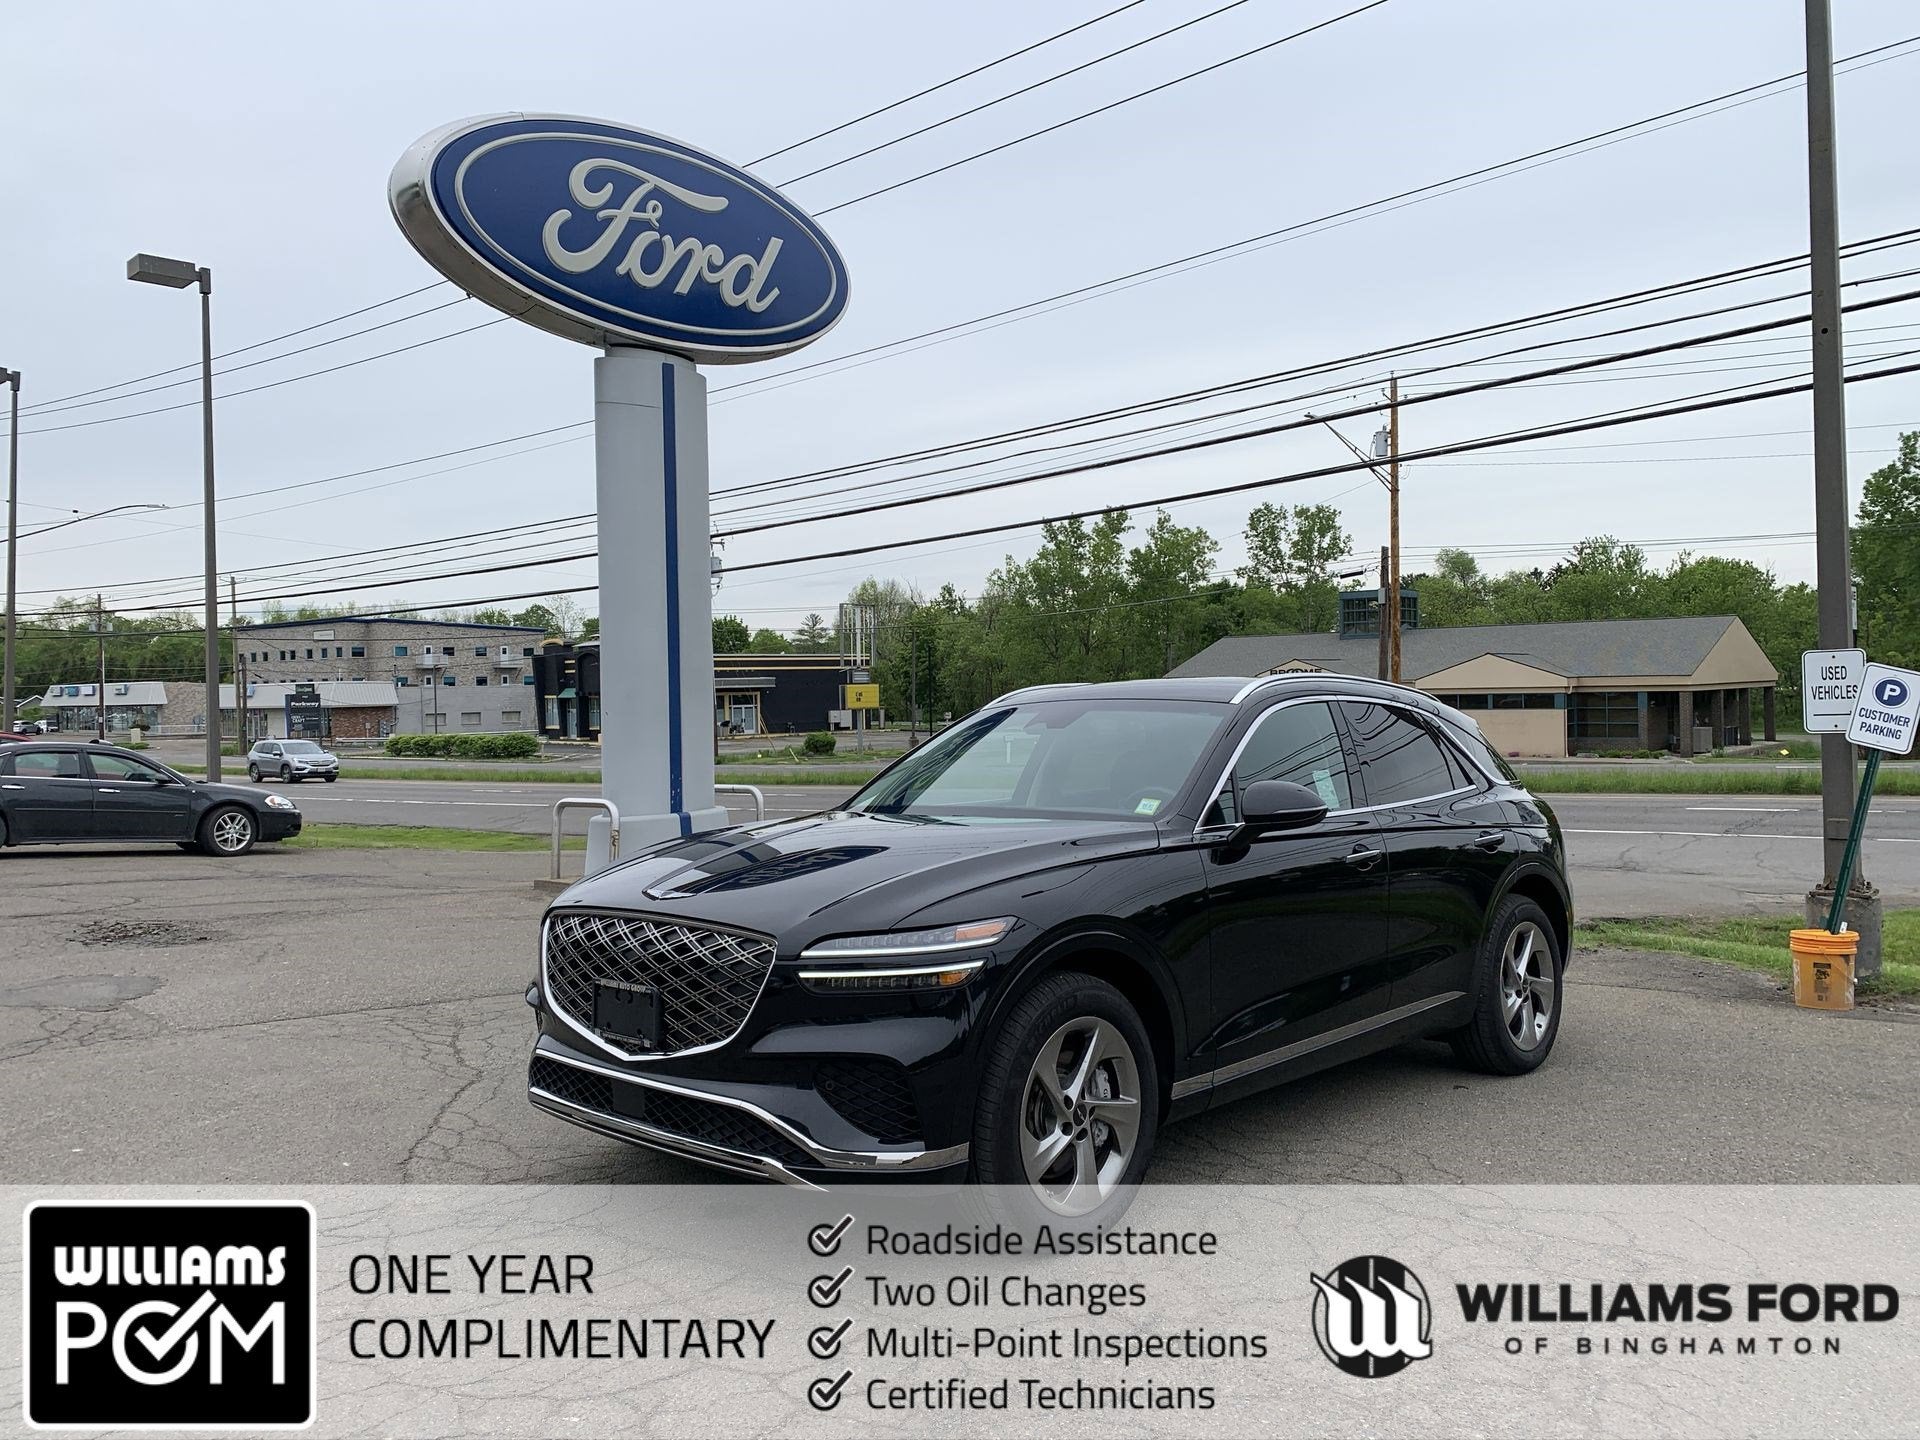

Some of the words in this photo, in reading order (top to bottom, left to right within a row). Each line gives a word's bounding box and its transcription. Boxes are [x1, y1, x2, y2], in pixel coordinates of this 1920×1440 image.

[542, 158, 784, 313] Ford
[1821, 666, 1847, 680] USED
[1811, 685, 1858, 700] VEHICLES
[1883, 684, 1901, 701] P
[1858, 707, 1911, 728] CUSTOMER
[1859, 722, 1903, 740] PARKING
